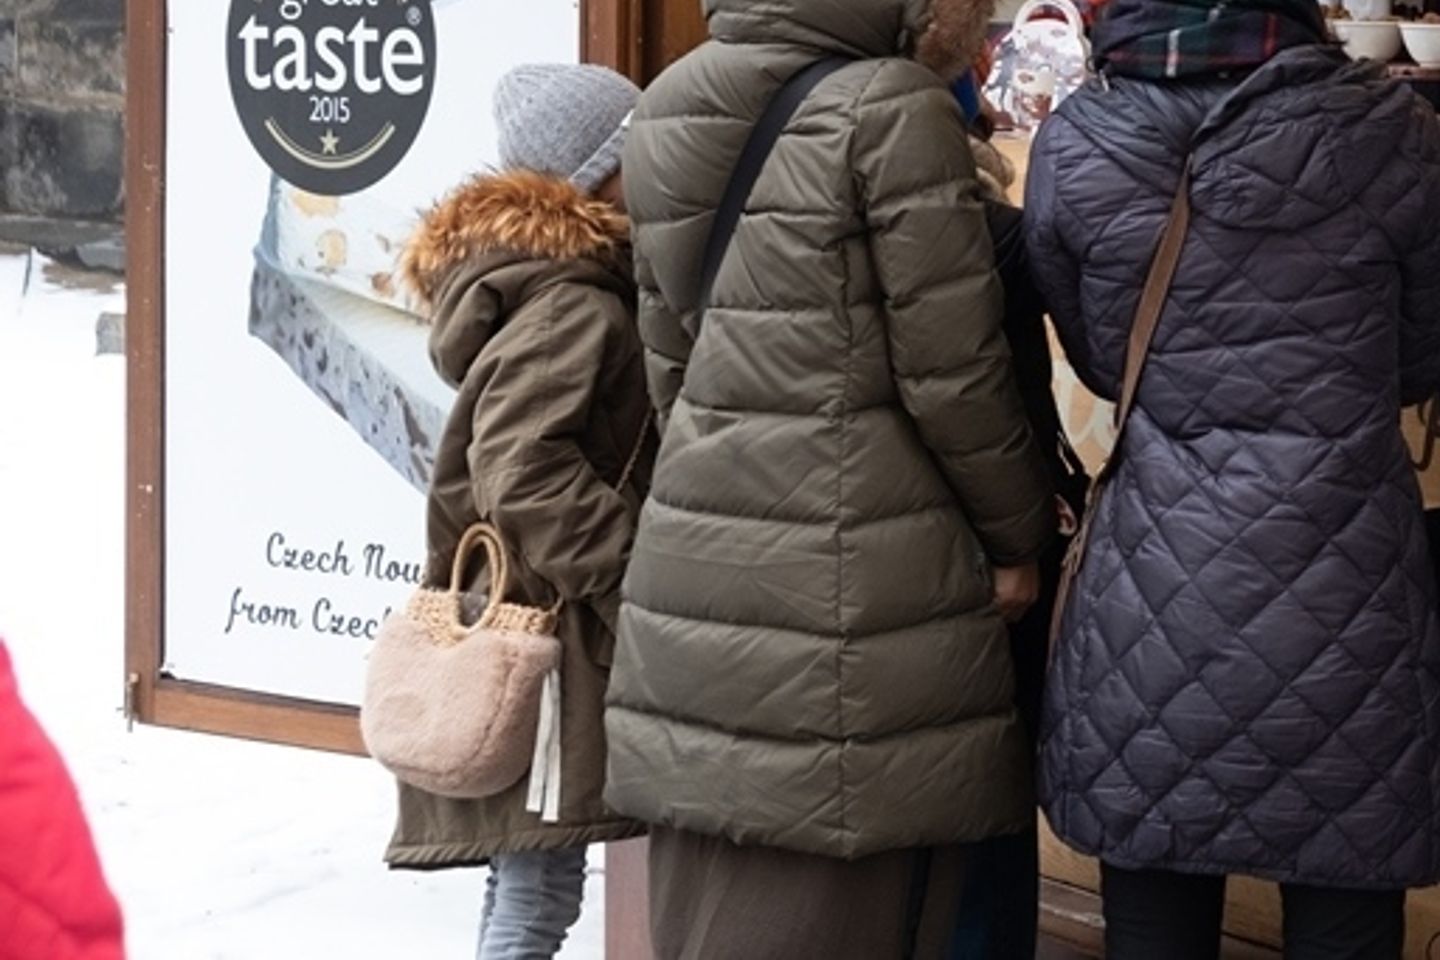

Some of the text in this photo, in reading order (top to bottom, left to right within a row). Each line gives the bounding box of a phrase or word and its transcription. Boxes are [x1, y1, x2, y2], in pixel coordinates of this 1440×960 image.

[237, 14, 424, 95] taste
[309, 96, 350, 123] 2015
[267, 532, 425, 584] Czech Nou
[224, 587, 301, 634] from
